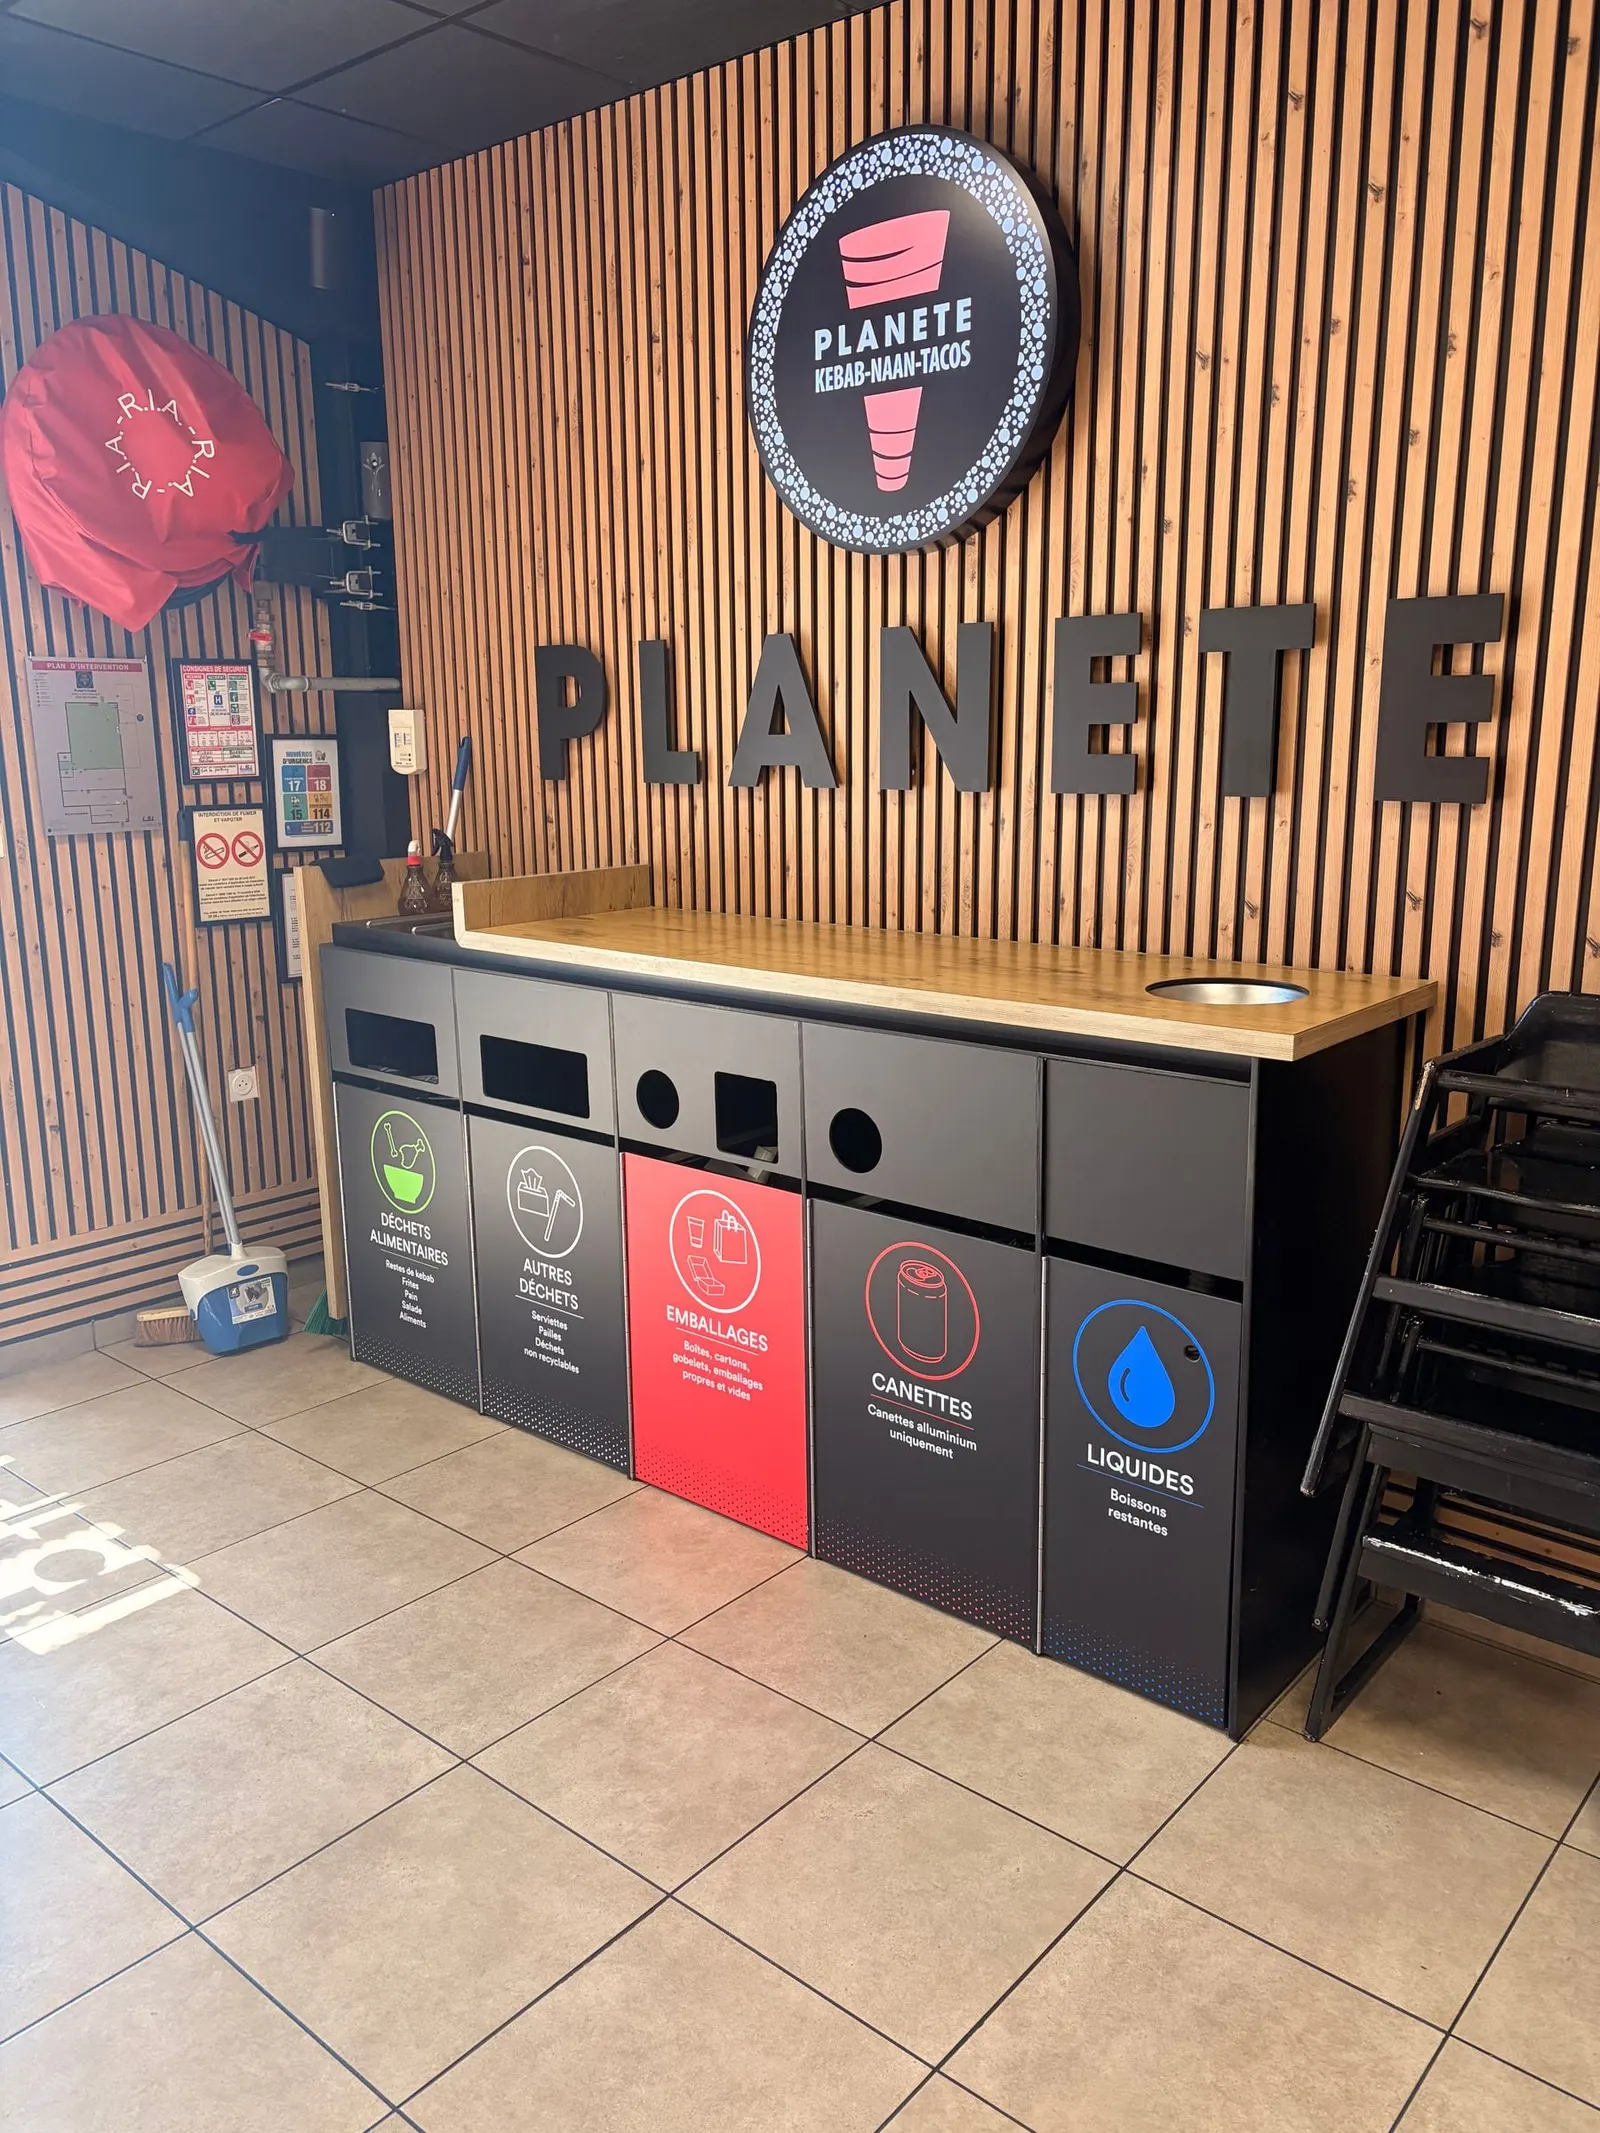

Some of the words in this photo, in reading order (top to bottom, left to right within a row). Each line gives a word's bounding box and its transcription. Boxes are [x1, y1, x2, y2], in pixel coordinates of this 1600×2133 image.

[814, 297, 972, 361] PLANETE
[815, 339, 971, 393] KEBAB-NAAN-TACOS
[46, 662, 66, 670] PLAN
[70, 662, 129, 671] D'INTERVENTION
[534, 592, 1507, 804] PLANETE
[288, 780, 301, 792] 17
[314, 780, 327, 792] 18
[290, 808, 303, 821] 15
[312, 808, 330, 820] 114
[313, 822, 331, 833] 112
[380, 1211, 432, 1241] DÉCHETS
[370, 1228, 449, 1267] ALIMENTAIRES
[385, 1258, 406, 1274] Restes
[405, 1266, 415, 1277] de
[415, 1269, 435, 1284] kebab
[401, 1276, 420, 1291] Frites
[523, 1257, 573, 1287] AUTRES
[401, 1300, 423, 1316] Salade
[404, 1289, 419, 1302] Pain
[519, 1277, 579, 1311] DÉCHETS
[399, 1310, 427, 1329] Aliments
[531, 1309, 569, 1331] Serviettes
[538, 1325, 562, 1342] Pailles
[666, 1304, 769, 1353] EMBALLAGES
[535, 1336, 565, 1356] Déchets
[523, 1347, 538, 1359] non
[538, 1351, 580, 1375] recyclables
[672, 1352, 712, 1375] gobelets,
[713, 1366, 764, 1392] emballages
[714, 1353, 751, 1374] cartons,
[682, 1370, 716, 1390] propres
[716, 1382, 726, 1393] et
[727, 1386, 752, 1402] vides
[871, 1371, 973, 1421] CANETTES
[867, 1403, 915, 1430] Canettes
[916, 1421, 978, 1452] alluminium
[889, 1428, 955, 1460] uniquement
[1086, 1442, 1194, 1496] LIQUIDES
[1110, 1488, 1167, 1518] Boissons
[1108, 1507, 1169, 1535] restantes
